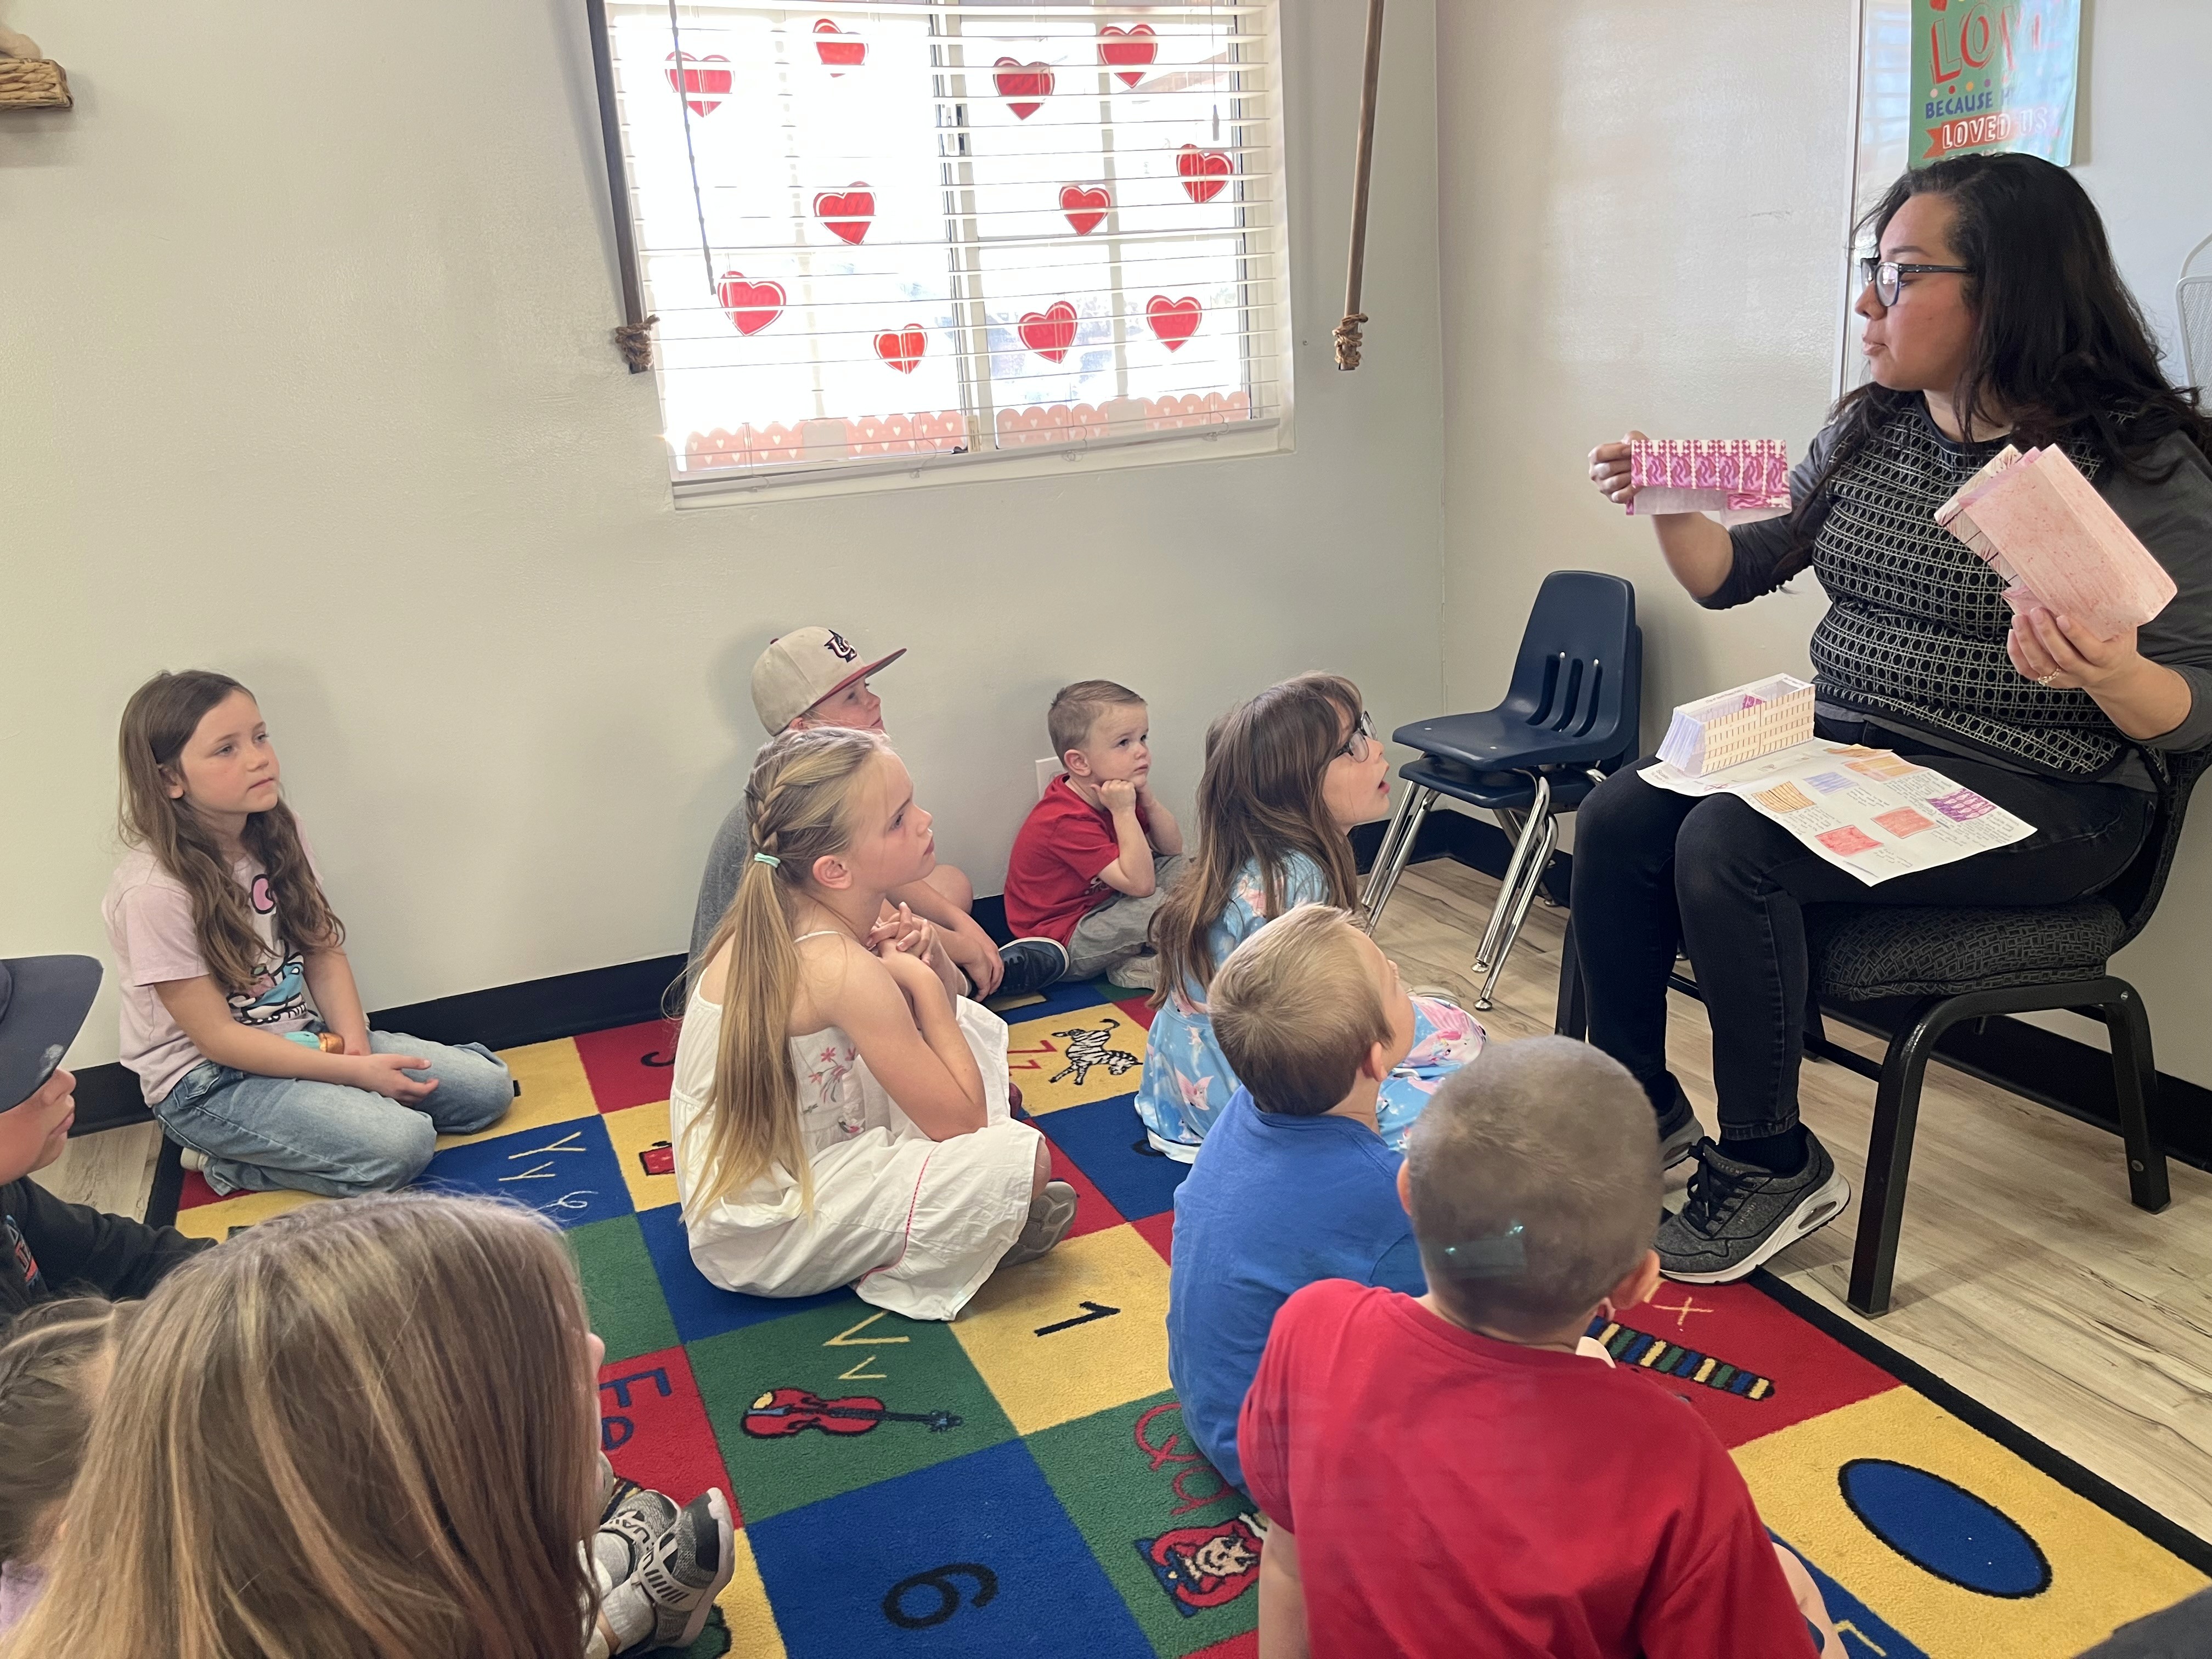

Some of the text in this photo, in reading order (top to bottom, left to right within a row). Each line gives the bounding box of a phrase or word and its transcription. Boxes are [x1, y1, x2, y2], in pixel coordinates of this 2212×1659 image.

[1926, 90, 1993, 119] BECAUSE
[1943, 106, 2048, 149] LOVED US
[1034, 1301, 1121, 1337] 1
[882, 1562, 998, 1630] 6
